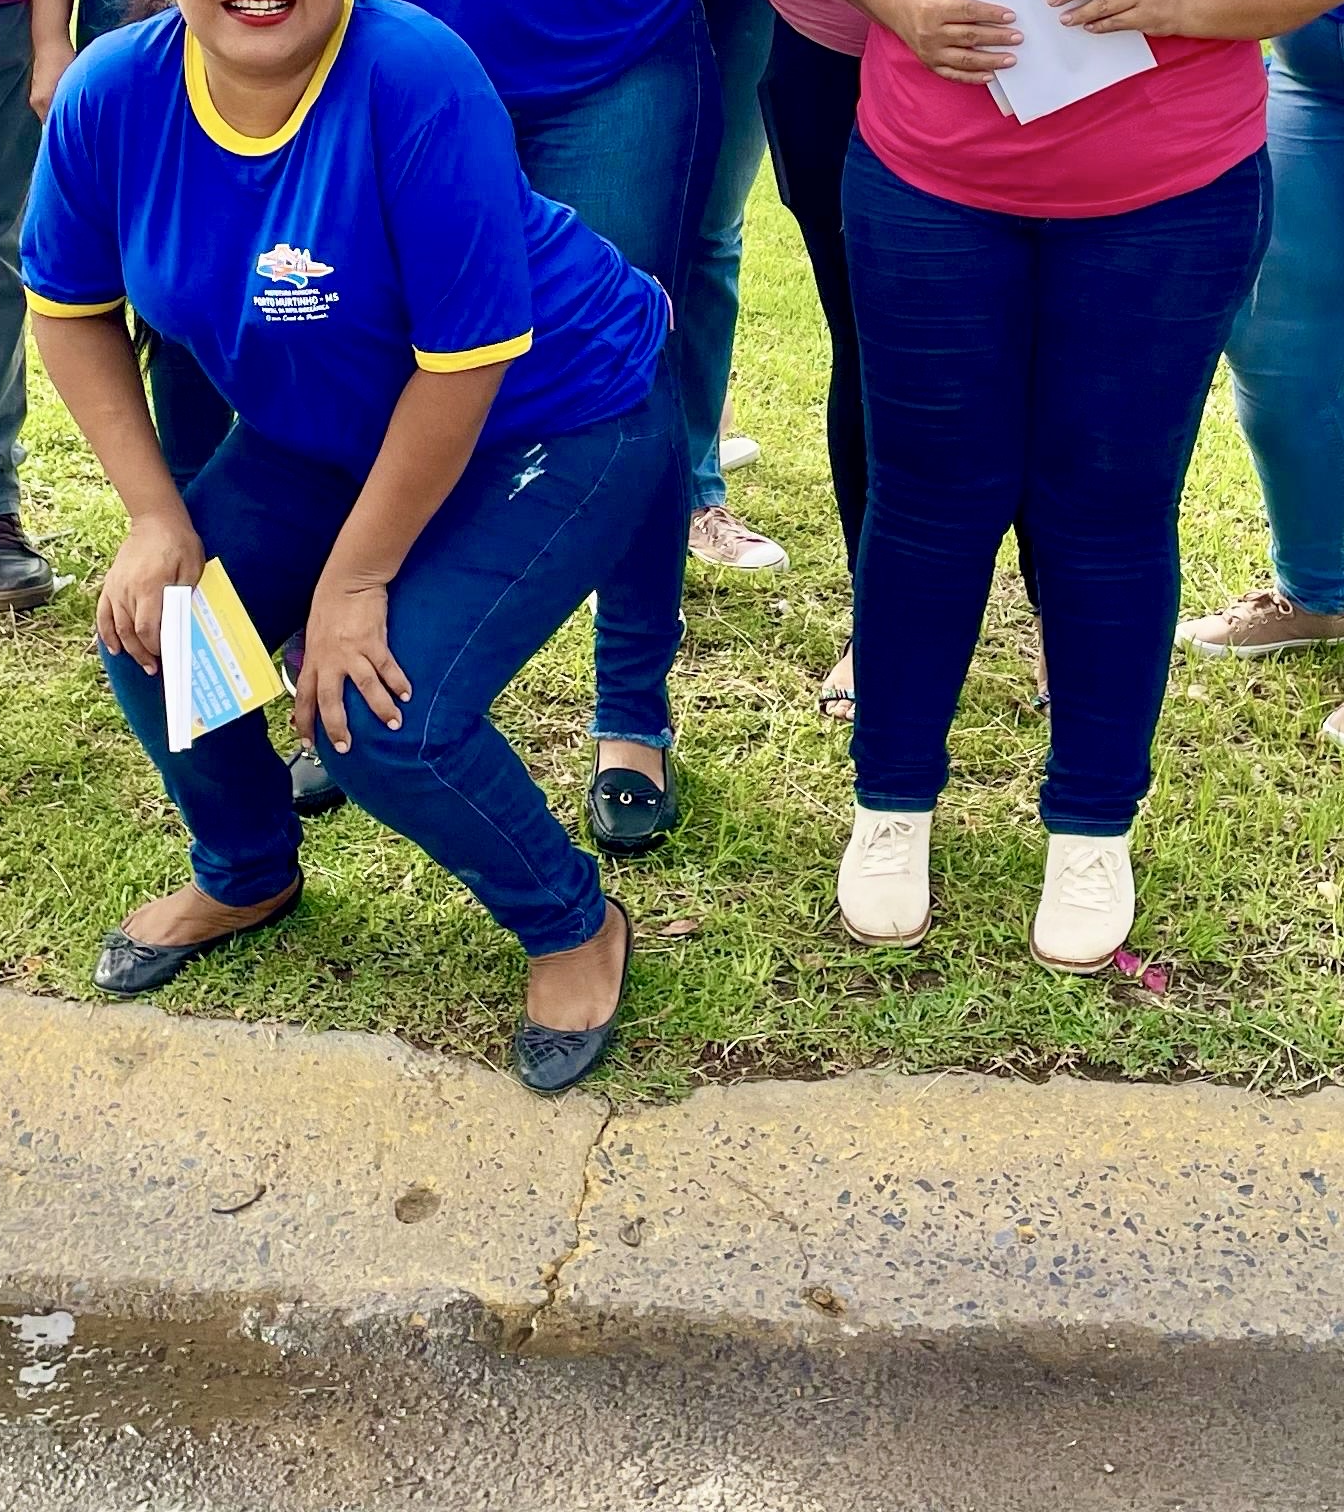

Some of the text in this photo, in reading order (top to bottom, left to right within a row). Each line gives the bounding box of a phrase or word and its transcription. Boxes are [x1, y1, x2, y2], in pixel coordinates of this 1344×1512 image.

[253, 296, 275, 307] PORTO
[275, 296, 318, 307] MURTINHO
[325, 292, 339, 303] MS
